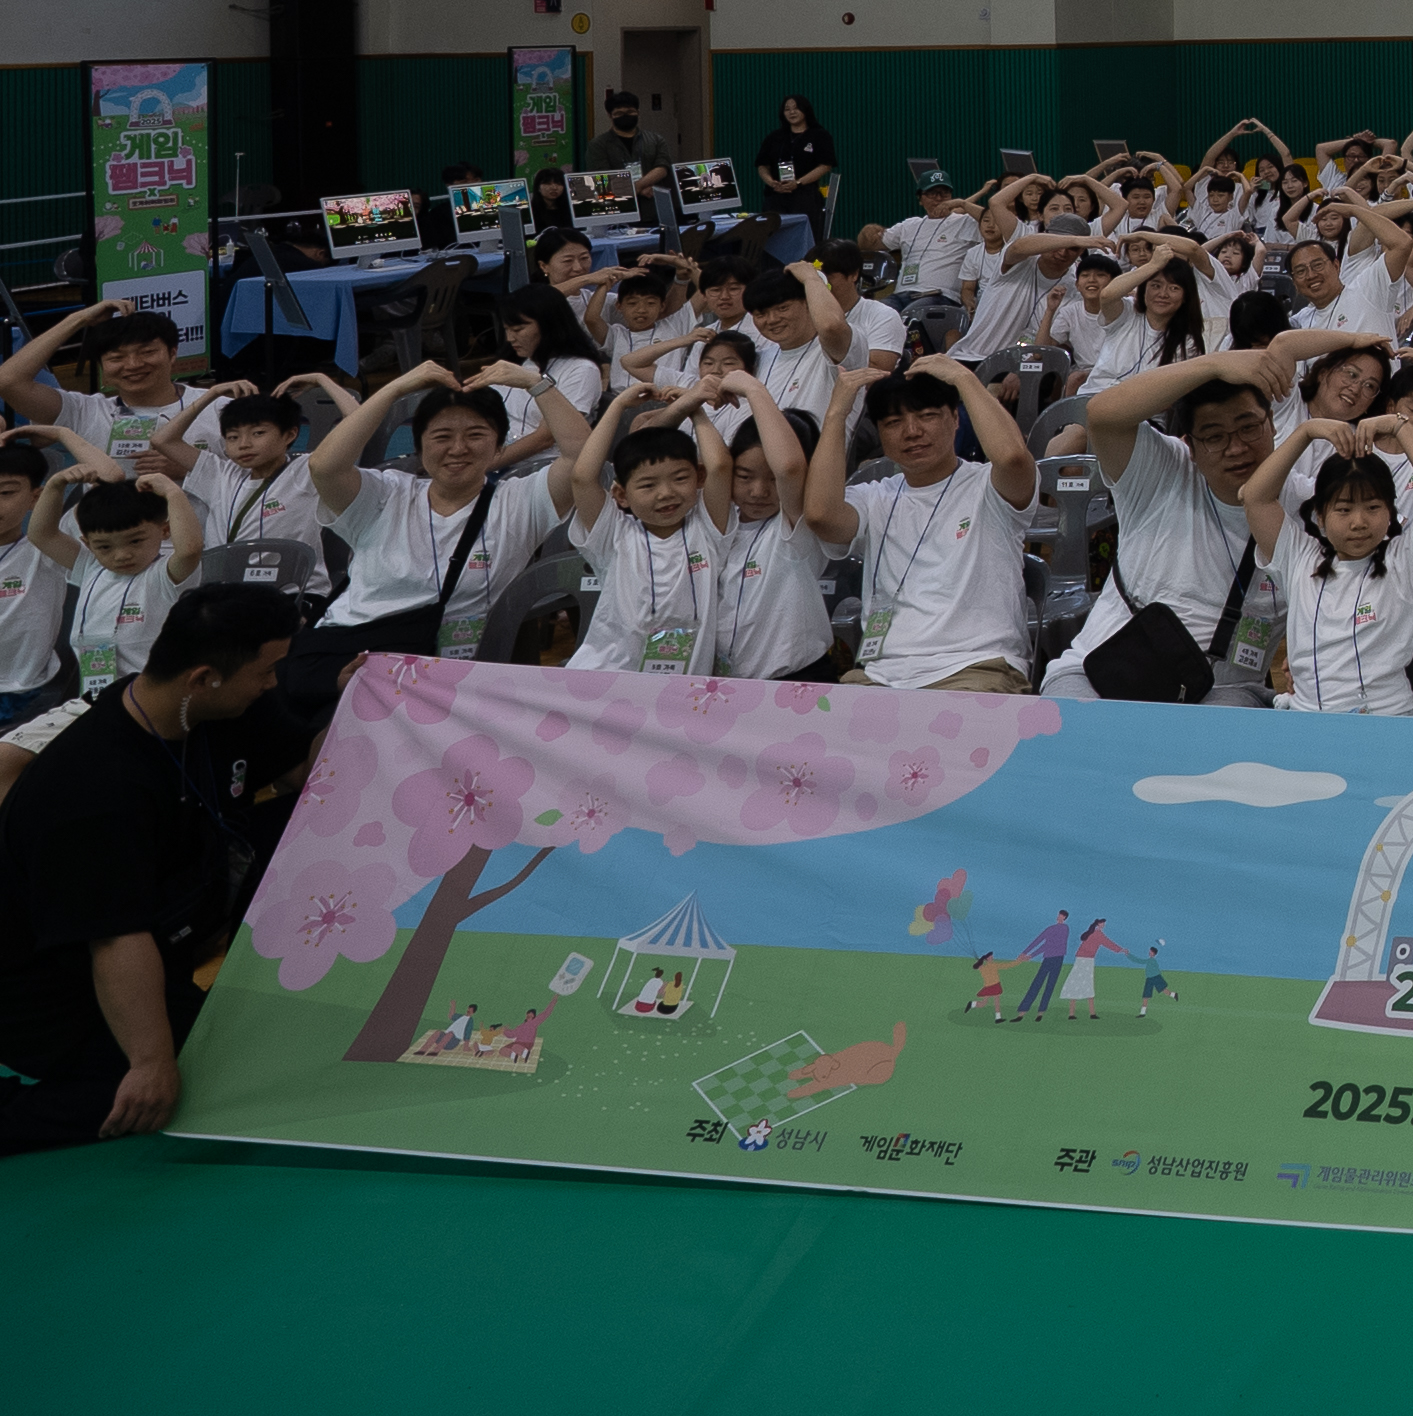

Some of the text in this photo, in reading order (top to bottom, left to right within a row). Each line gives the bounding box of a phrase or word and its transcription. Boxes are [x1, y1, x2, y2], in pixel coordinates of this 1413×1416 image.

[528, 94, 558, 114] 게임
[124, 131, 180, 161] 게임
[685, 1118, 1097, 1174] 주최 성남시 게임문화재단 주관
[1146, 1154, 1250, 1182] 성남산업진흥원
